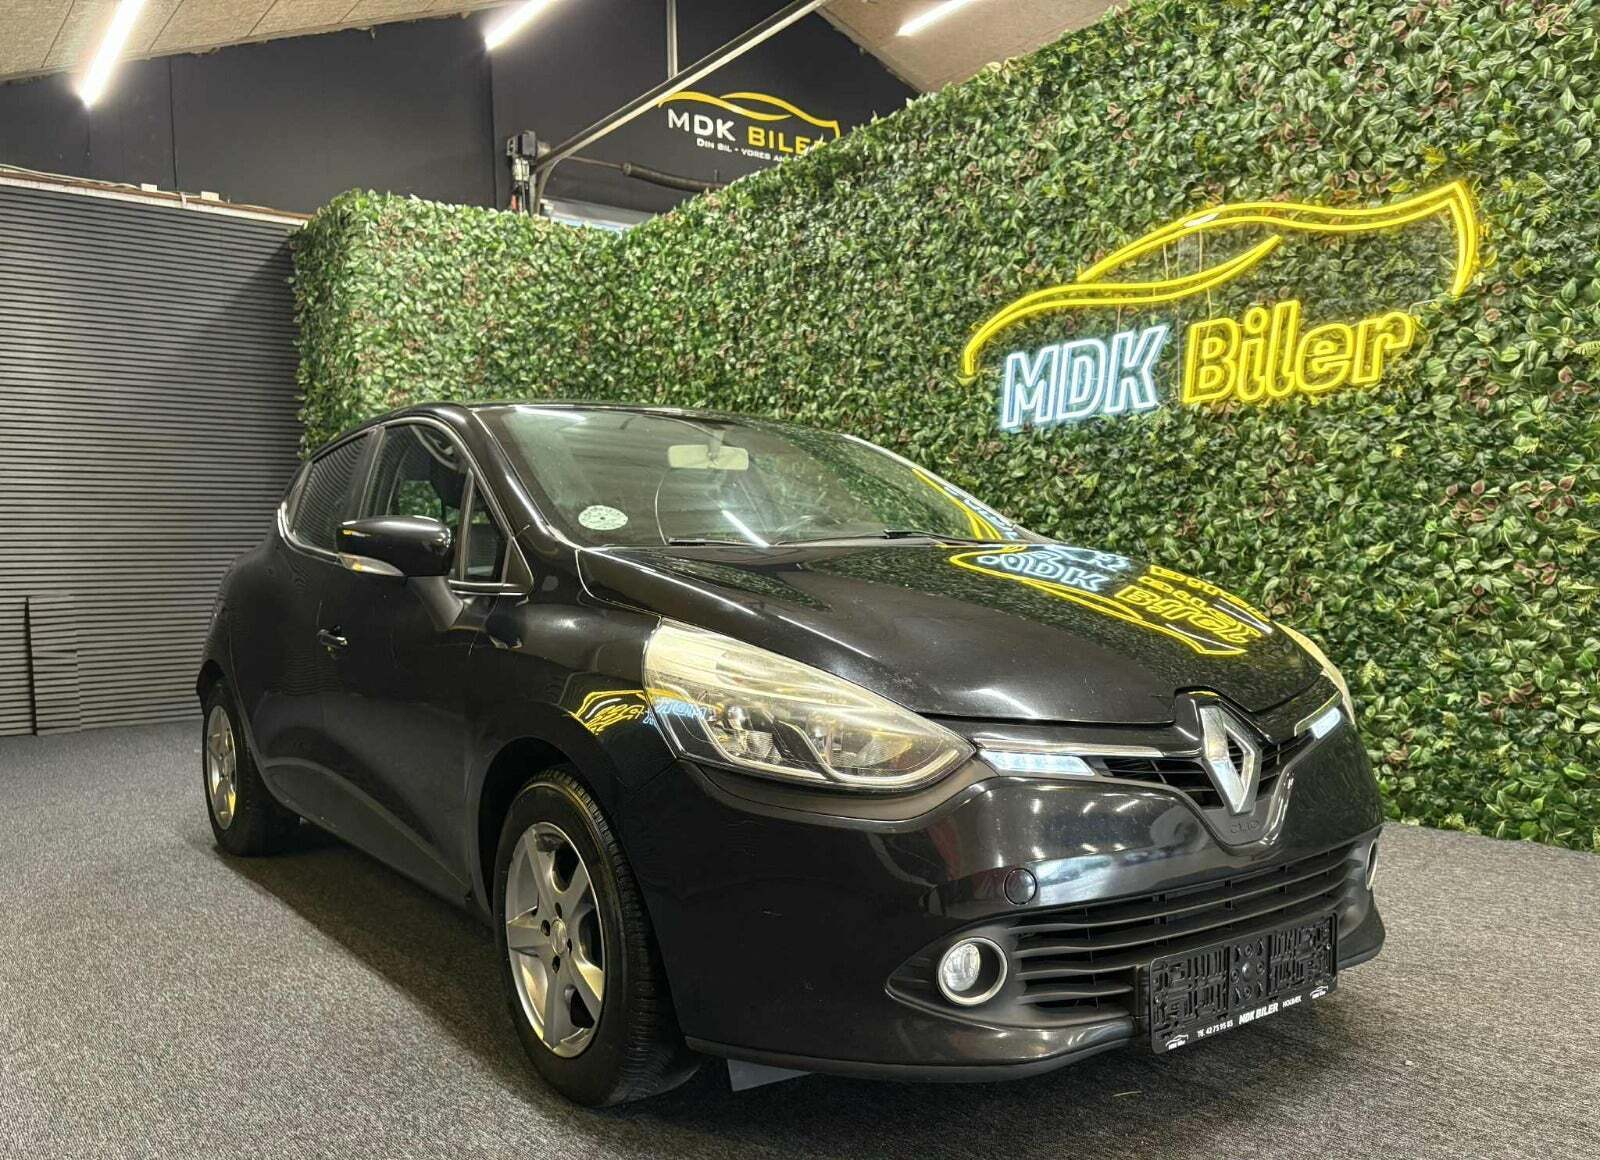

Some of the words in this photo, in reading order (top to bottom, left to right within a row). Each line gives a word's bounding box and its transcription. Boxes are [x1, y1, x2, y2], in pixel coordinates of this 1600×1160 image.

[667, 108, 736, 142] MDK
[747, 126, 814, 155] BILE
[1000, 323, 1171, 430] MDK
[1182, 299, 1417, 404] Biler
[1238, 1010, 1255, 1024] MDK
[1255, 1002, 1278, 1019] BILER
